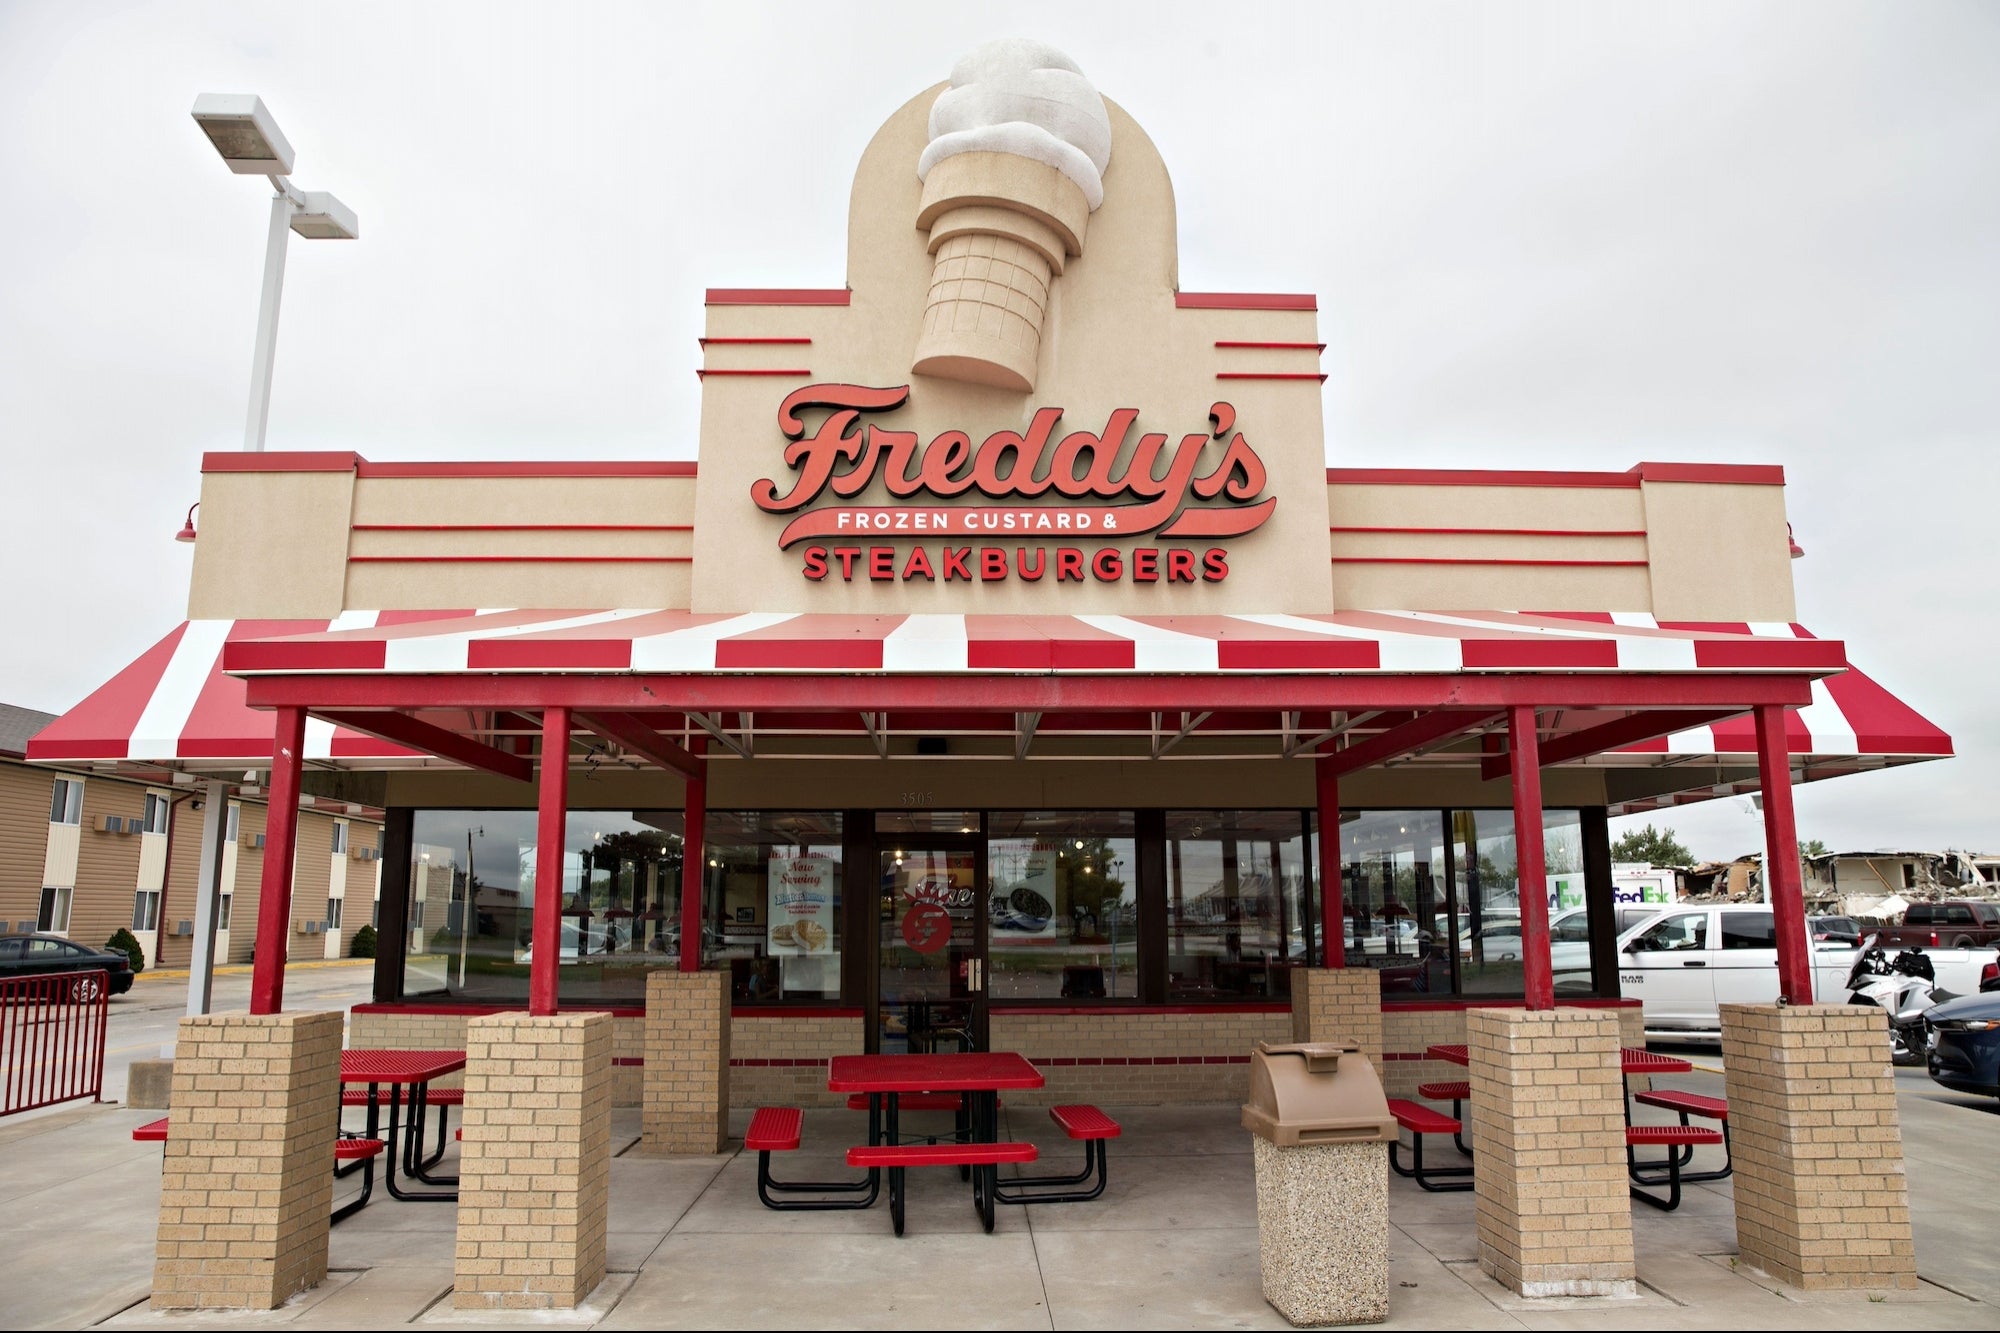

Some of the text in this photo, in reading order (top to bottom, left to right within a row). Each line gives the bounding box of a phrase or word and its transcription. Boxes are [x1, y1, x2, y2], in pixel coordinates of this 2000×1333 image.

[750, 383, 1276, 542] Freddy's
[837, 512, 1118, 530] FROZEN CUSTARD &
[802, 546, 1230, 583] STEAKBURGERS
[901, 791, 934, 806] 3505
[788, 860, 815, 872] Now
[780, 874, 821, 887] Serving
[1612, 886, 1670, 904] FedEx
